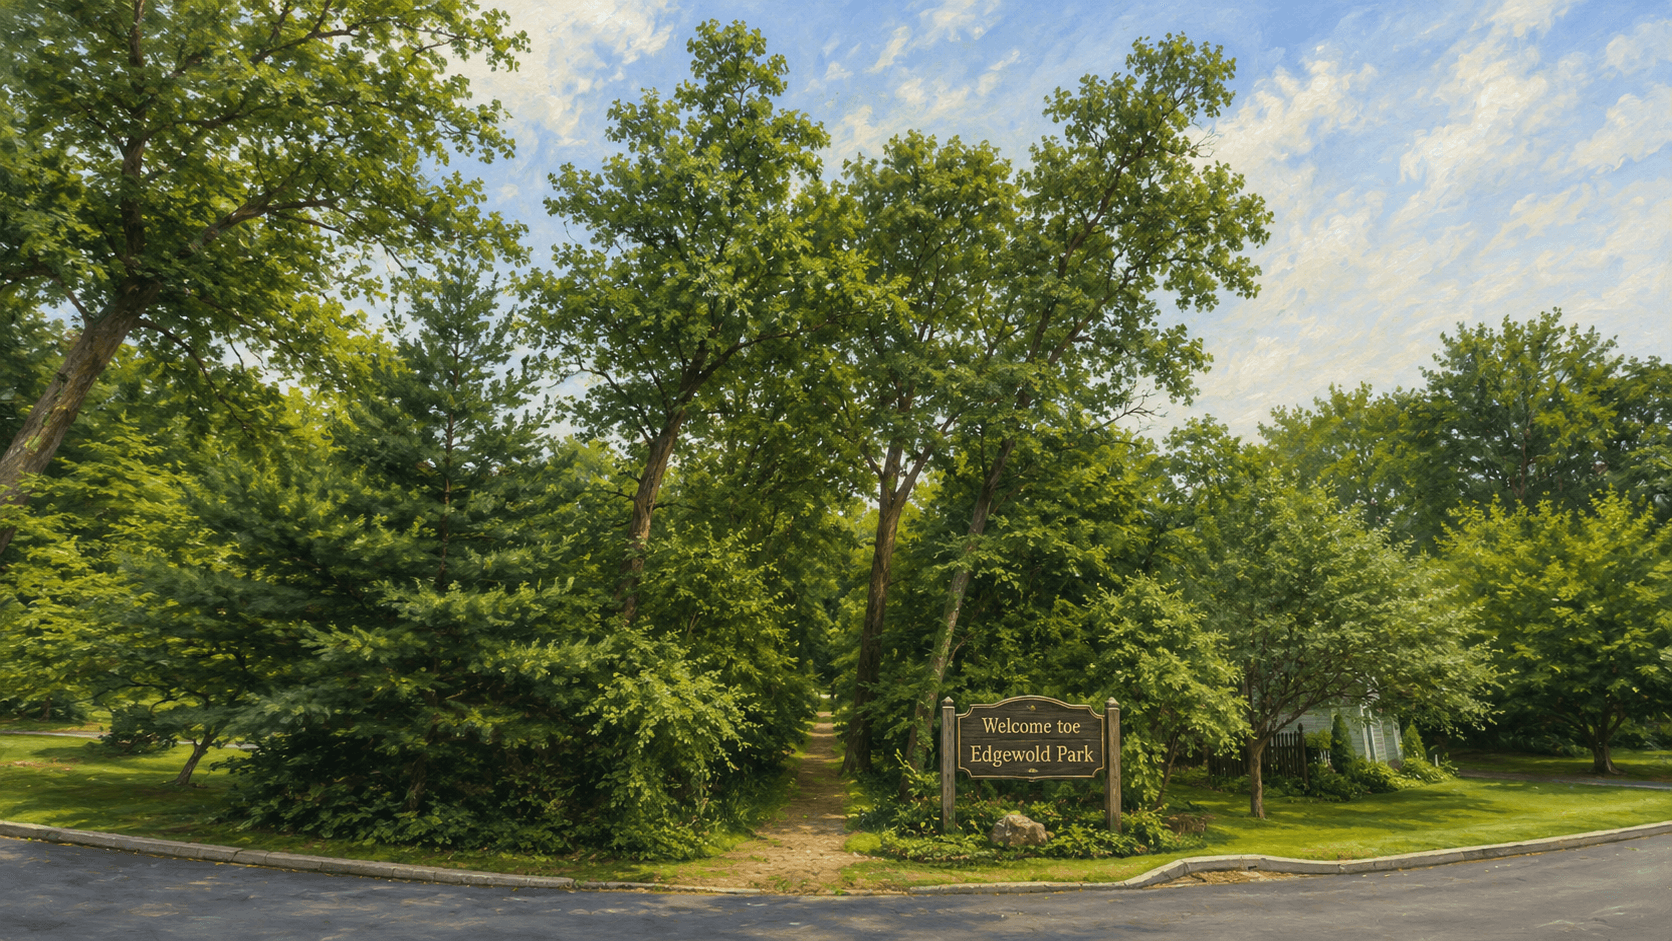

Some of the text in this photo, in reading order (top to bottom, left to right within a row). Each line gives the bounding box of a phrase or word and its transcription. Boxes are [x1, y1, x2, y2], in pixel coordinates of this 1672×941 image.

[981, 717, 1081, 734] Welcome toe
[970, 745, 1095, 767] Edgewold Park
